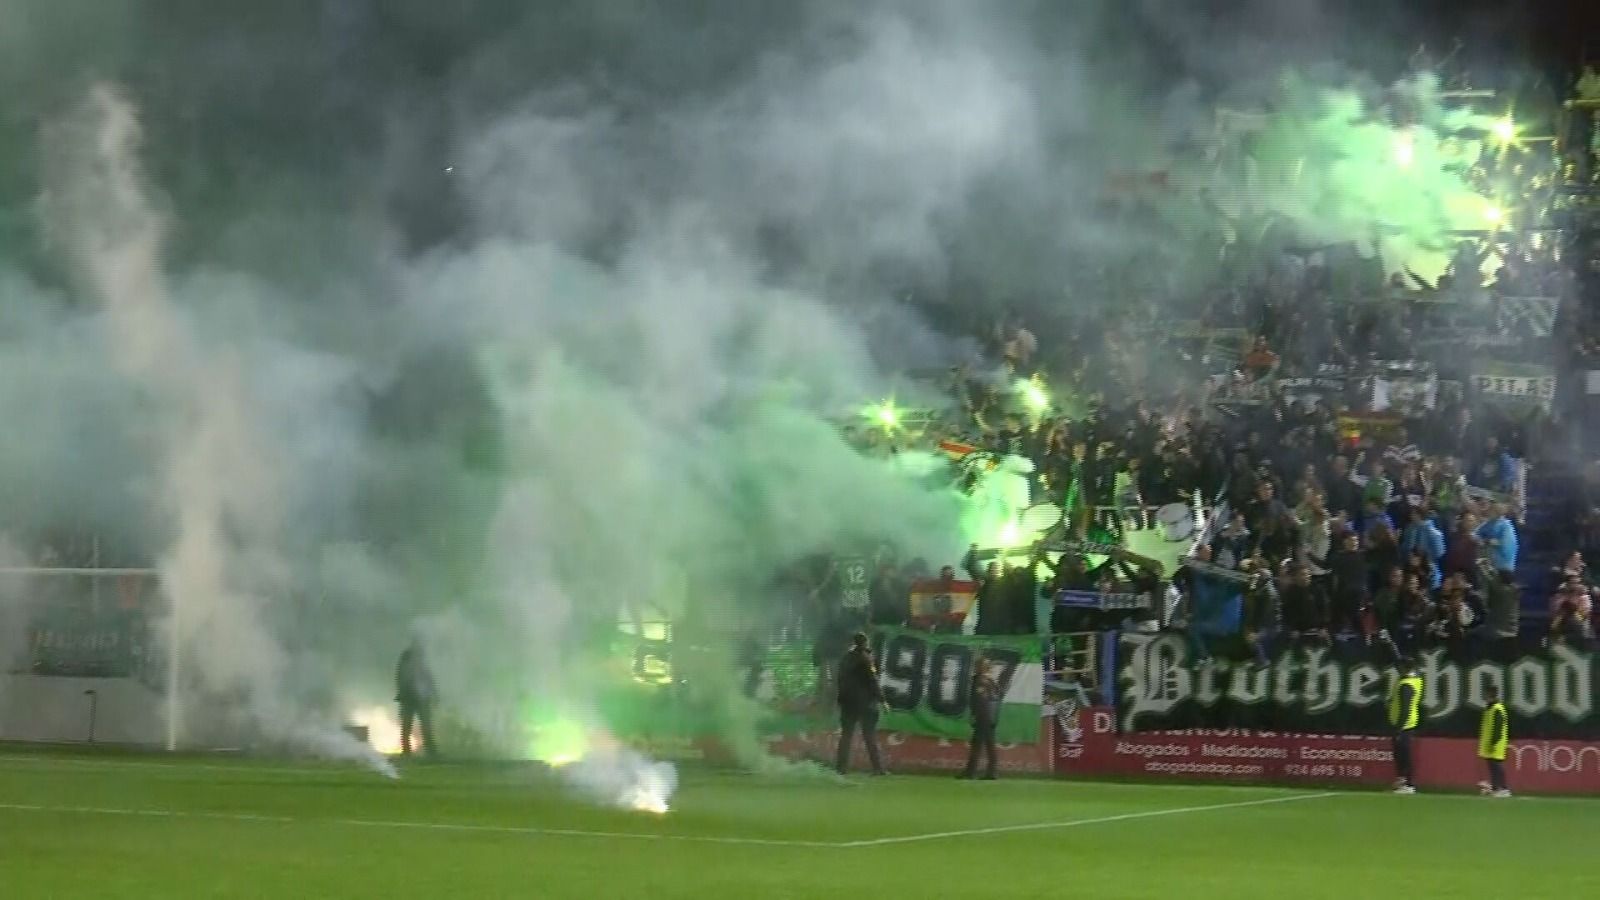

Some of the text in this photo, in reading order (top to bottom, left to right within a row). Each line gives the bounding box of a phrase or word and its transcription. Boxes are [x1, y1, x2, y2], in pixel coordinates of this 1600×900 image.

[847, 565, 865, 583] 12
[1119, 632, 1594, 731] Brotherhood
[1115, 742, 1190, 757] Abogados
[1201, 743, 1288, 759] Mediadores
